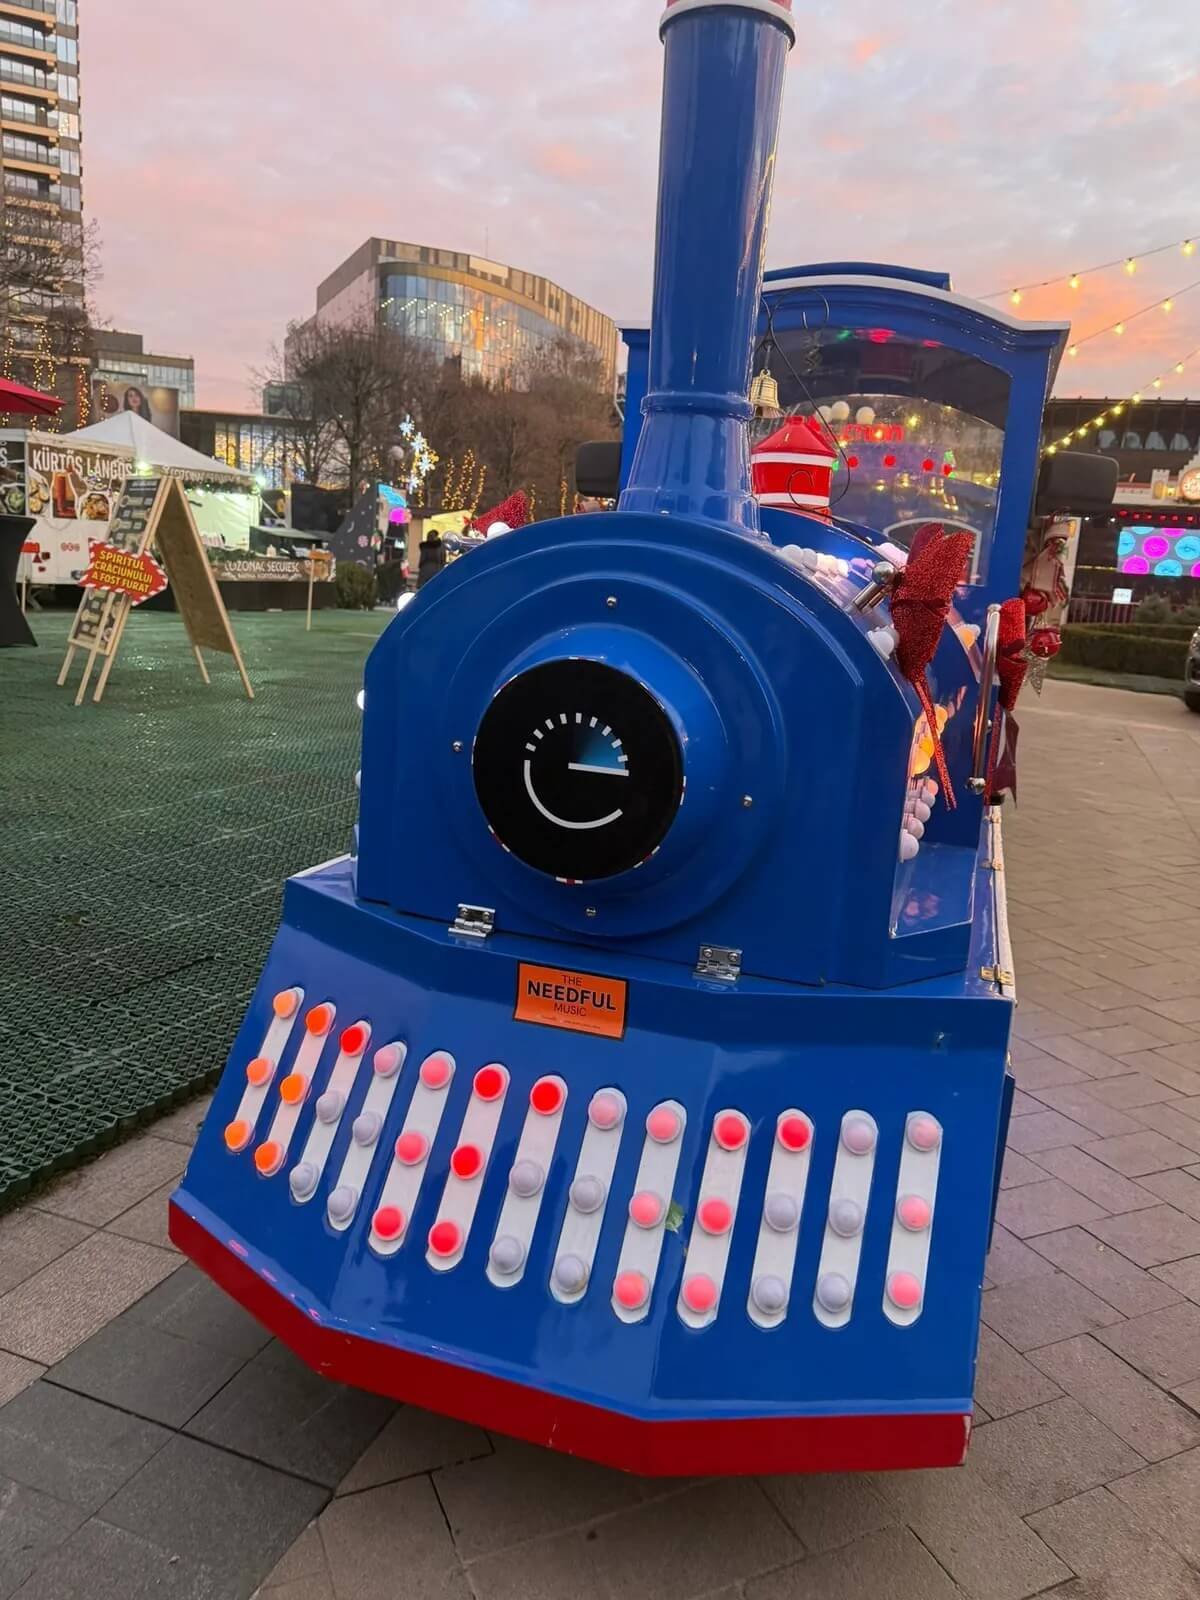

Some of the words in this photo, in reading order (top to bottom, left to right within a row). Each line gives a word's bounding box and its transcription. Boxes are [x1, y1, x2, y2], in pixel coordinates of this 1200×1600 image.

[99, 550, 145, 570] SPIRITUL
[91, 570, 98, 580] A
[99, 572, 121, 585] FOST
[121, 579, 150, 593] FURAT
[561, 974, 583, 987] THE
[527, 979, 617, 1011] NEEDFUL
[553, 1003, 587, 1017] MUSIC
